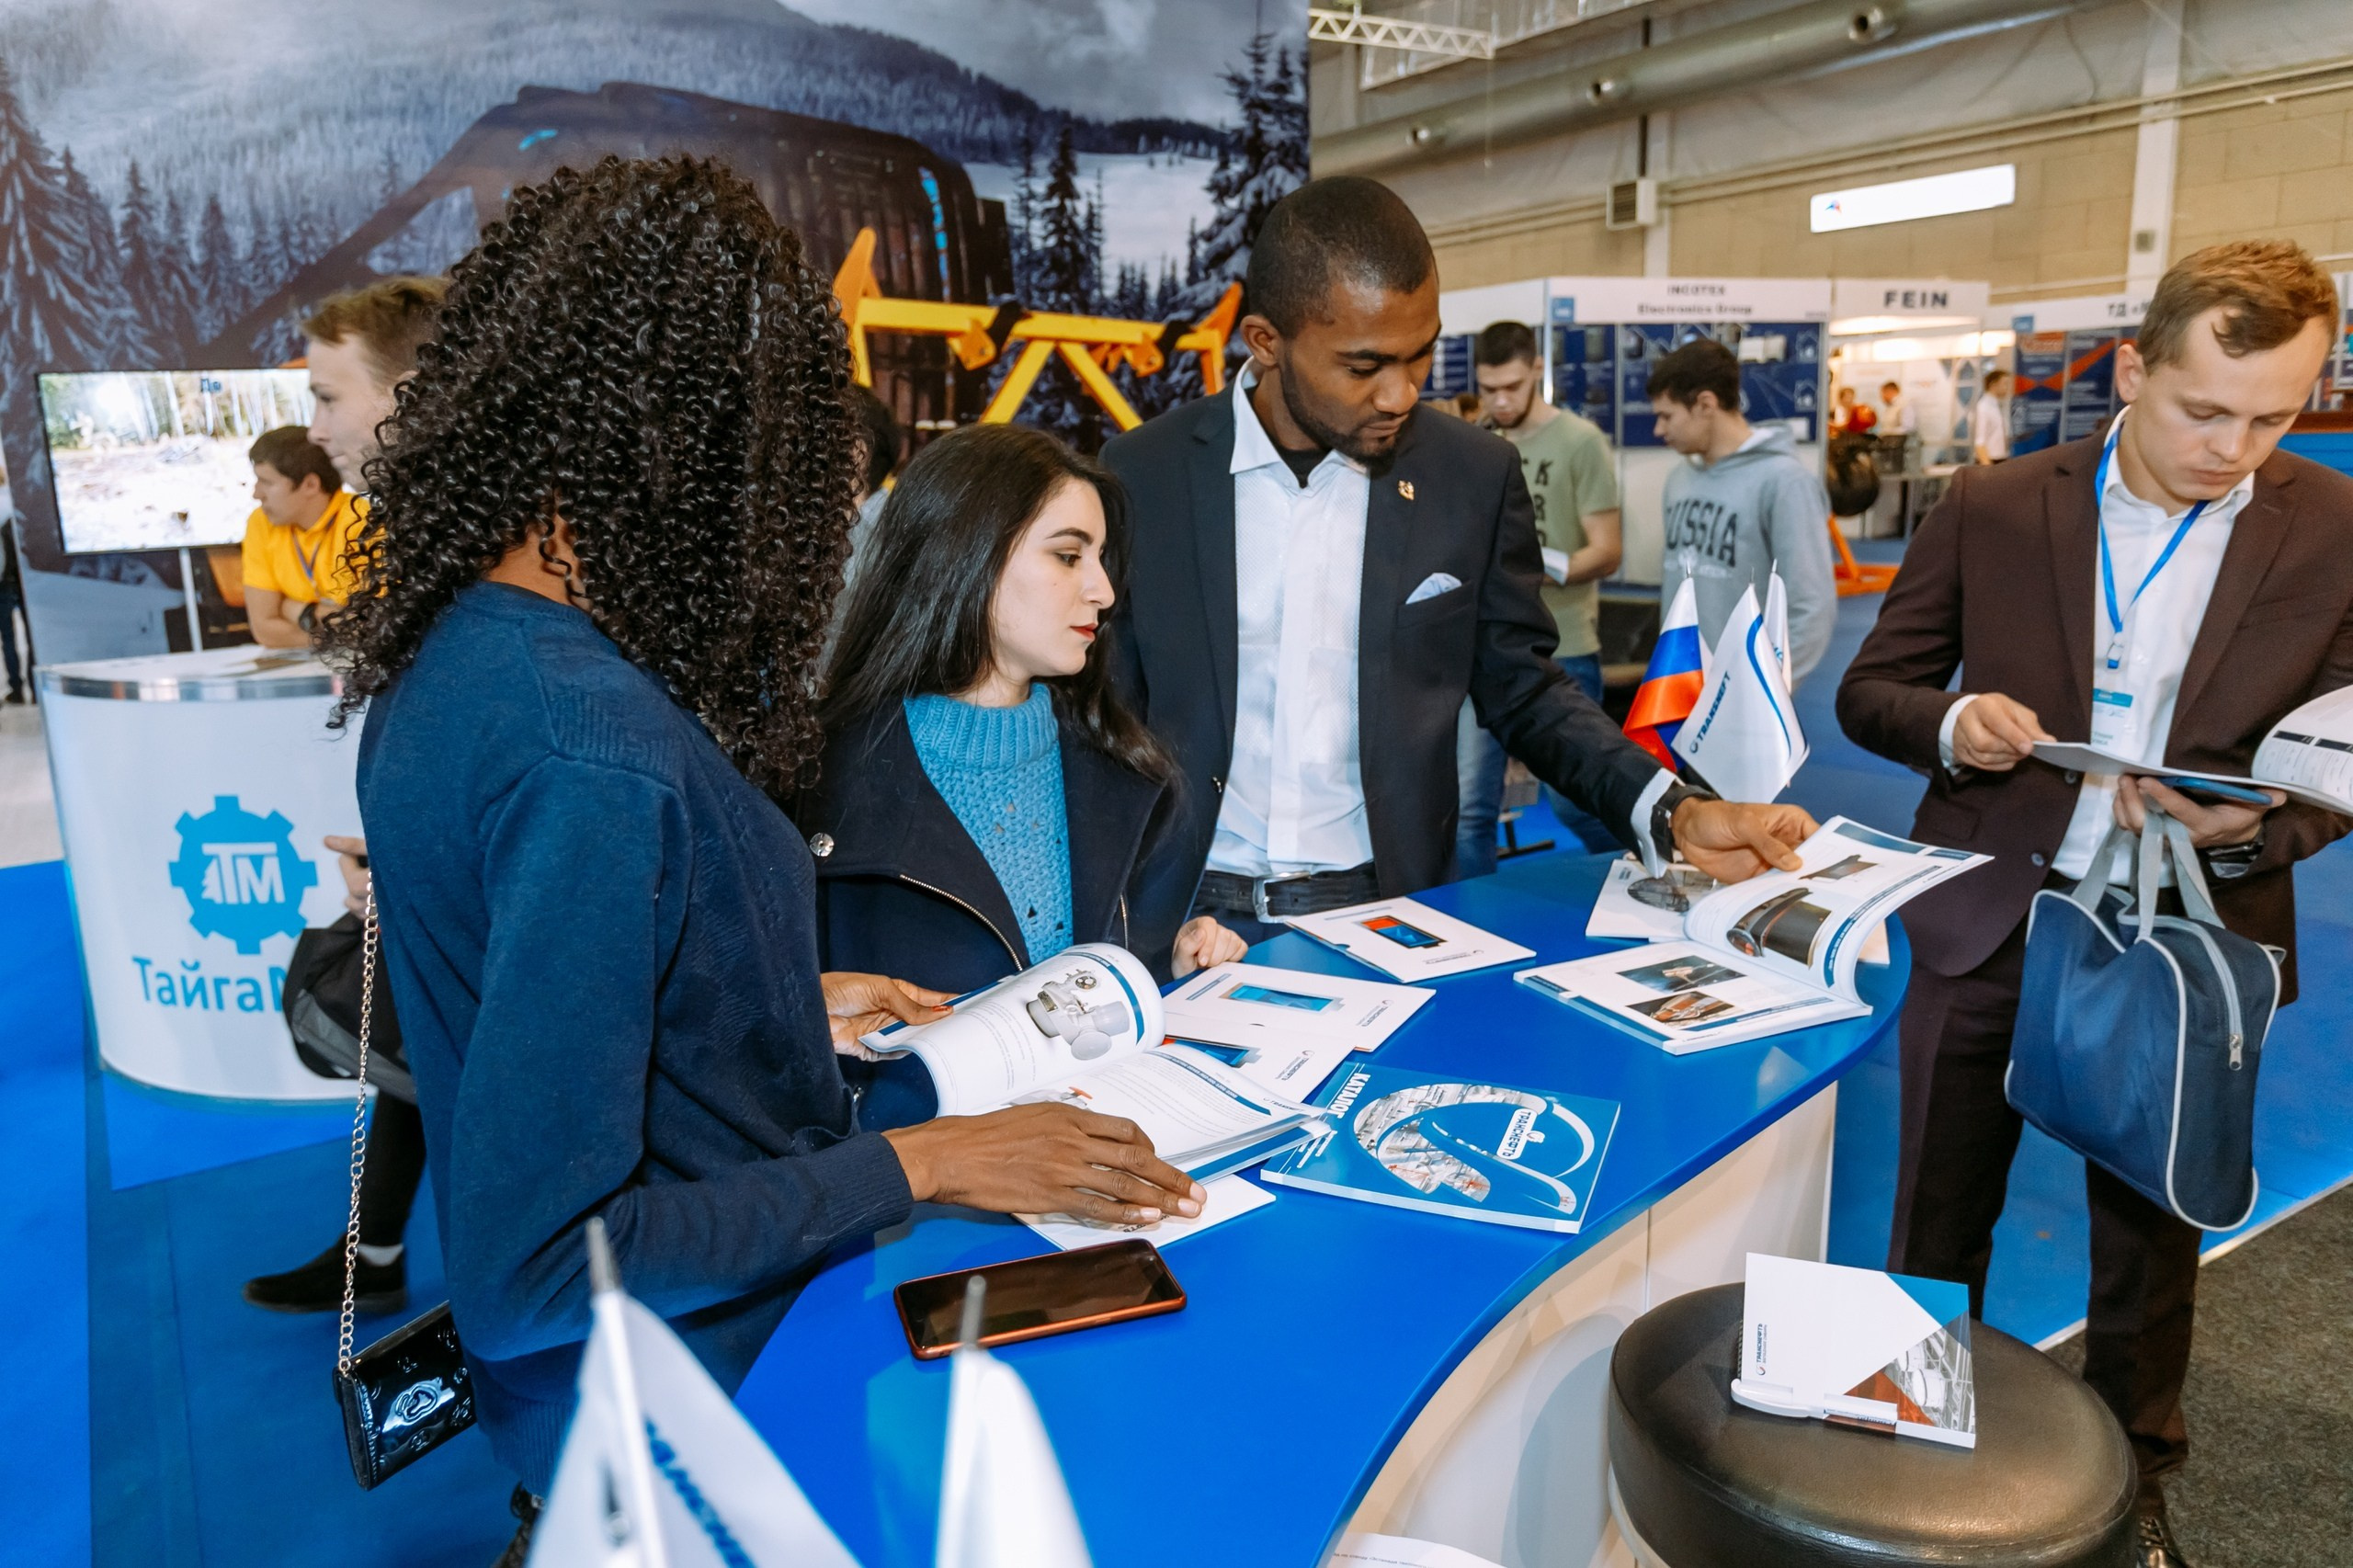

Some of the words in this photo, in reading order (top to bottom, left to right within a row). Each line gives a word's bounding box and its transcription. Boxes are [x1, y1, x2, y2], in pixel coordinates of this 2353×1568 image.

[1715, 303, 1753, 315] Group
[1883, 290, 1948, 308] FEIN
[1327, 1073, 1370, 1119] КАТАЛОГ
[1502, 1110, 1531, 1157] ТРАНСНЕФТЬ
